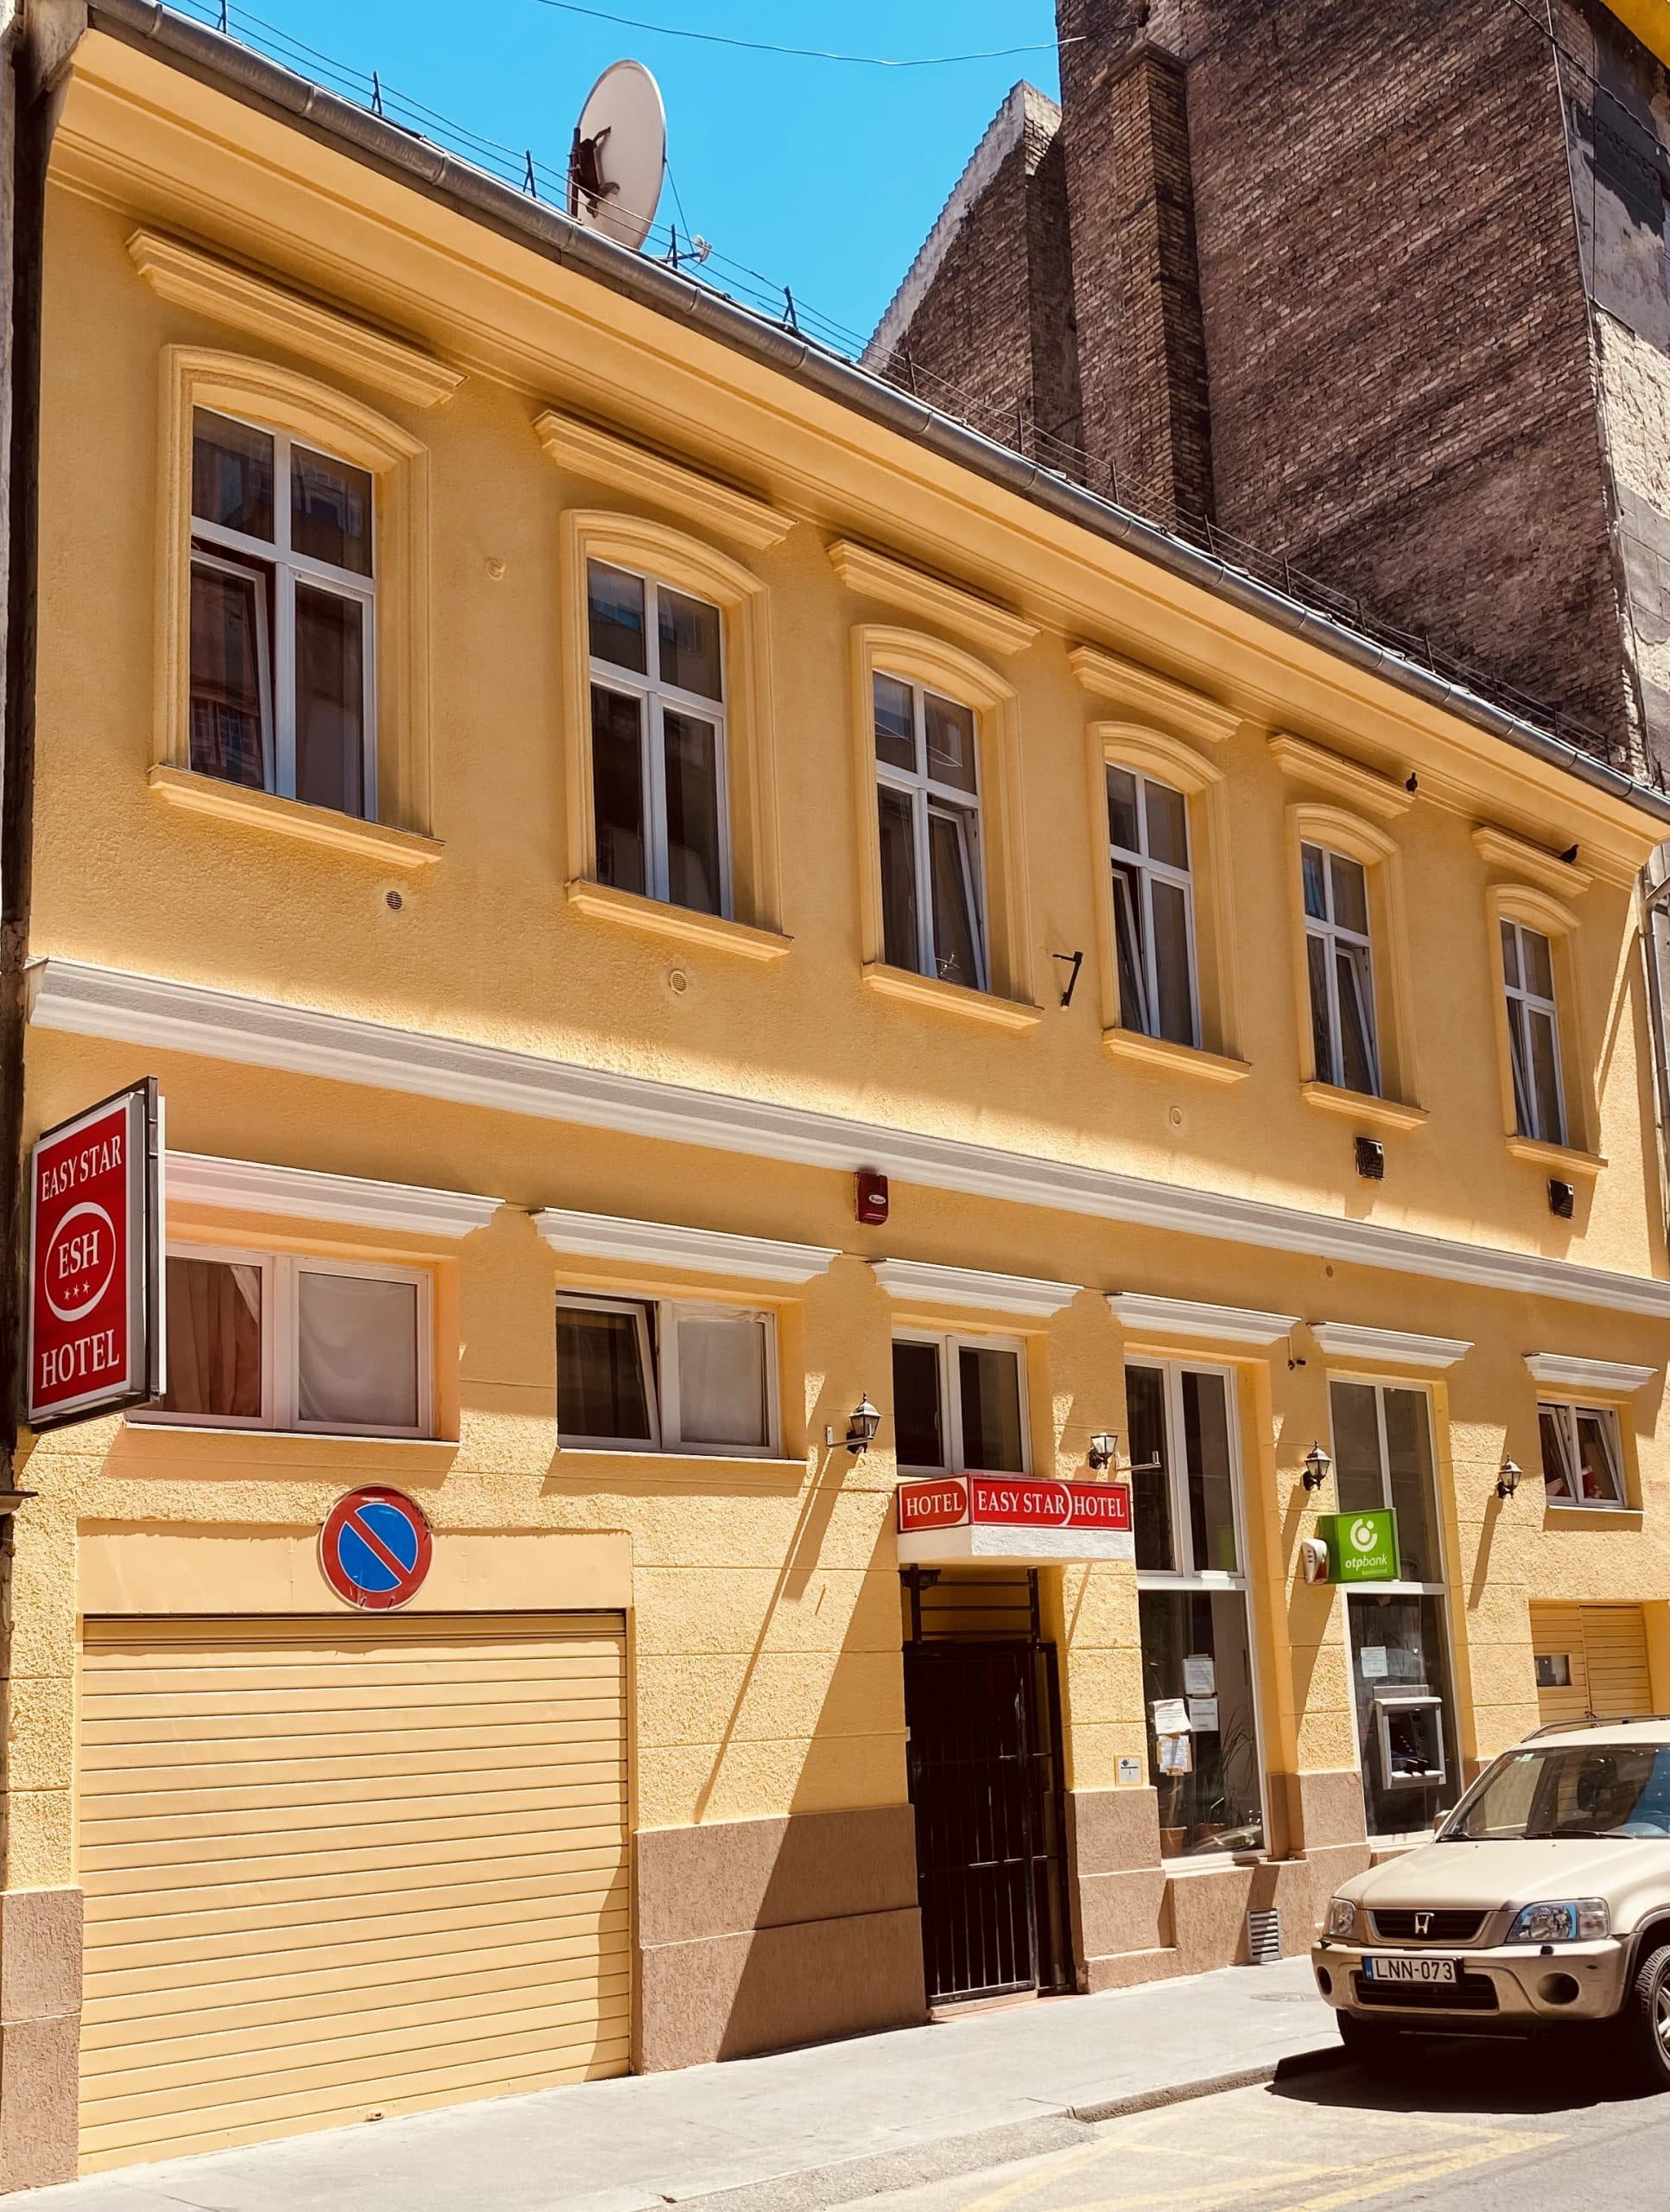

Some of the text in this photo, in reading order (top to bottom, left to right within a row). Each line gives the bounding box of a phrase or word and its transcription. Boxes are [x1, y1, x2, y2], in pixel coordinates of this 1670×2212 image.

[41, 1135, 122, 1202] EASY STAR
[58, 1230, 100, 1280] ESH
[41, 1328, 120, 1389] HOTEL
[905, 1492, 963, 1517] HOTEL
[977, 1490, 1125, 1518] EASY STAR HOTEL
[1345, 1553, 1387, 1571] otpbank
[1375, 1959, 1452, 1980] LNN-073
